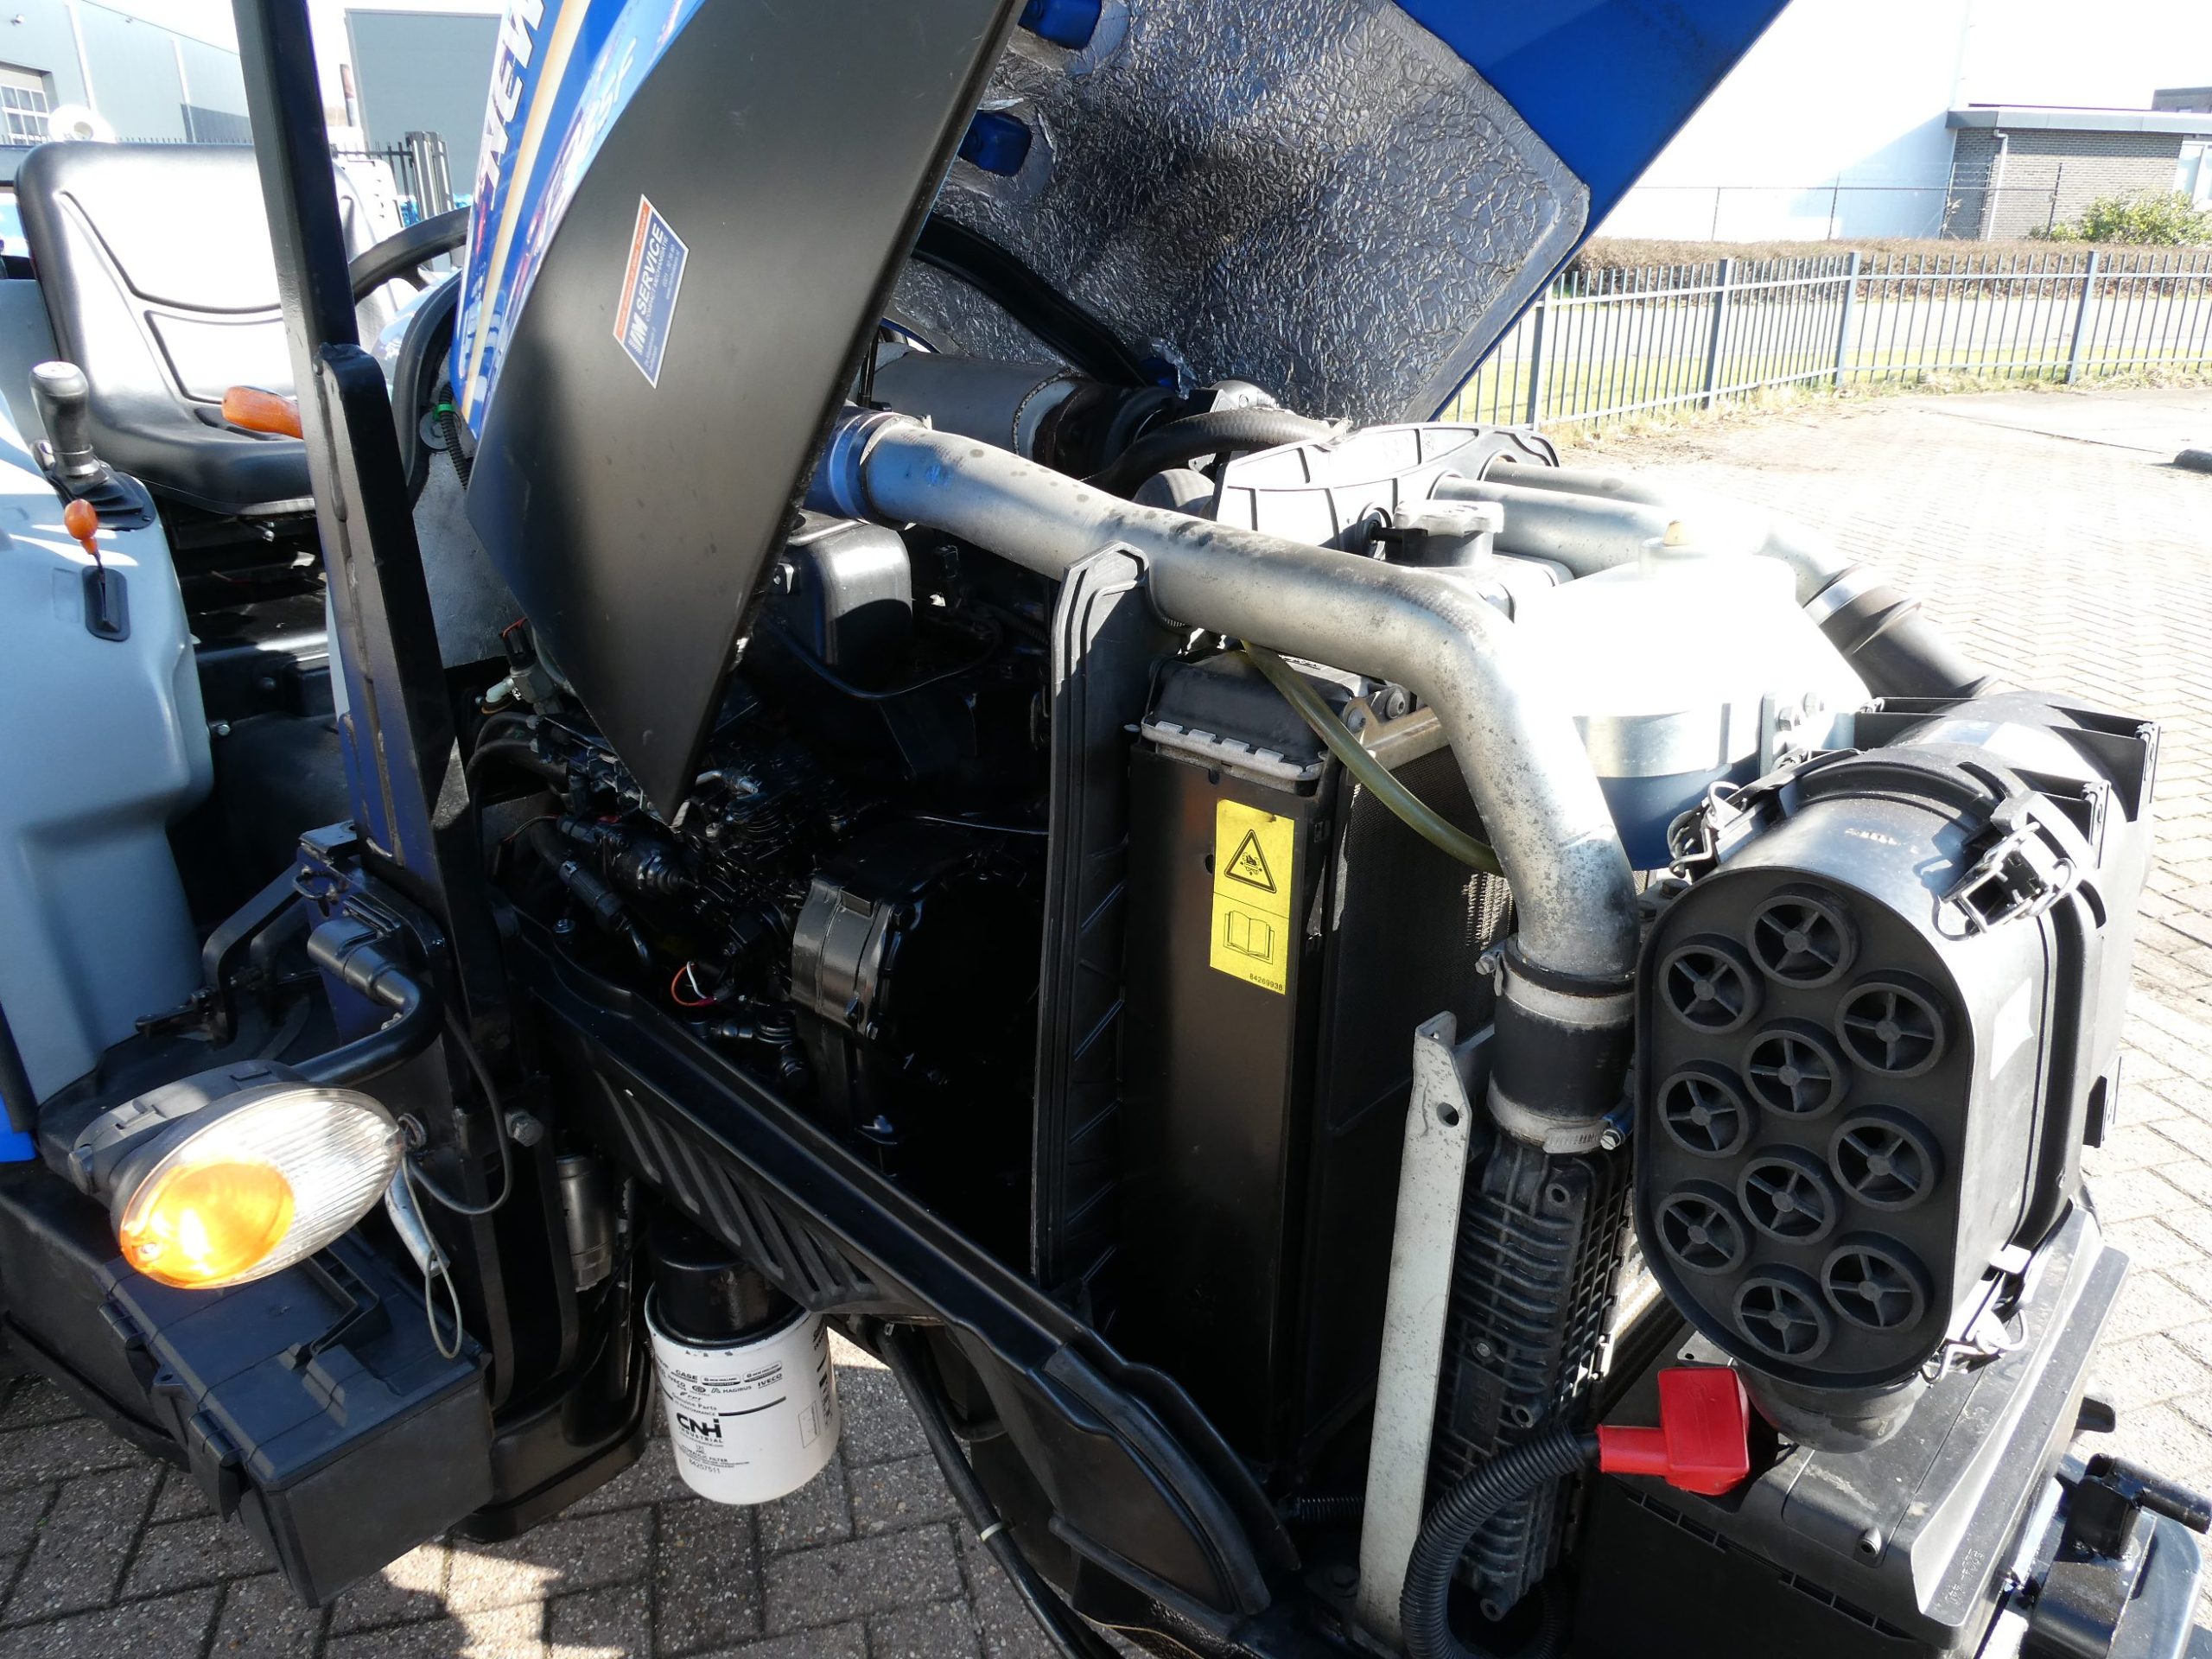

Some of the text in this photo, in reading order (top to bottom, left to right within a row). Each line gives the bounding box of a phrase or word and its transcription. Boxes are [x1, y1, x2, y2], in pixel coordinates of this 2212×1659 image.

[636, 223, 664, 315] SERVICE
[1249, 973, 1283, 991] 84269938
[676, 1370, 698, 1381] CASE
[757, 1373, 783, 1388] IVECO
[722, 1385, 752, 1394] MAGIRUS
